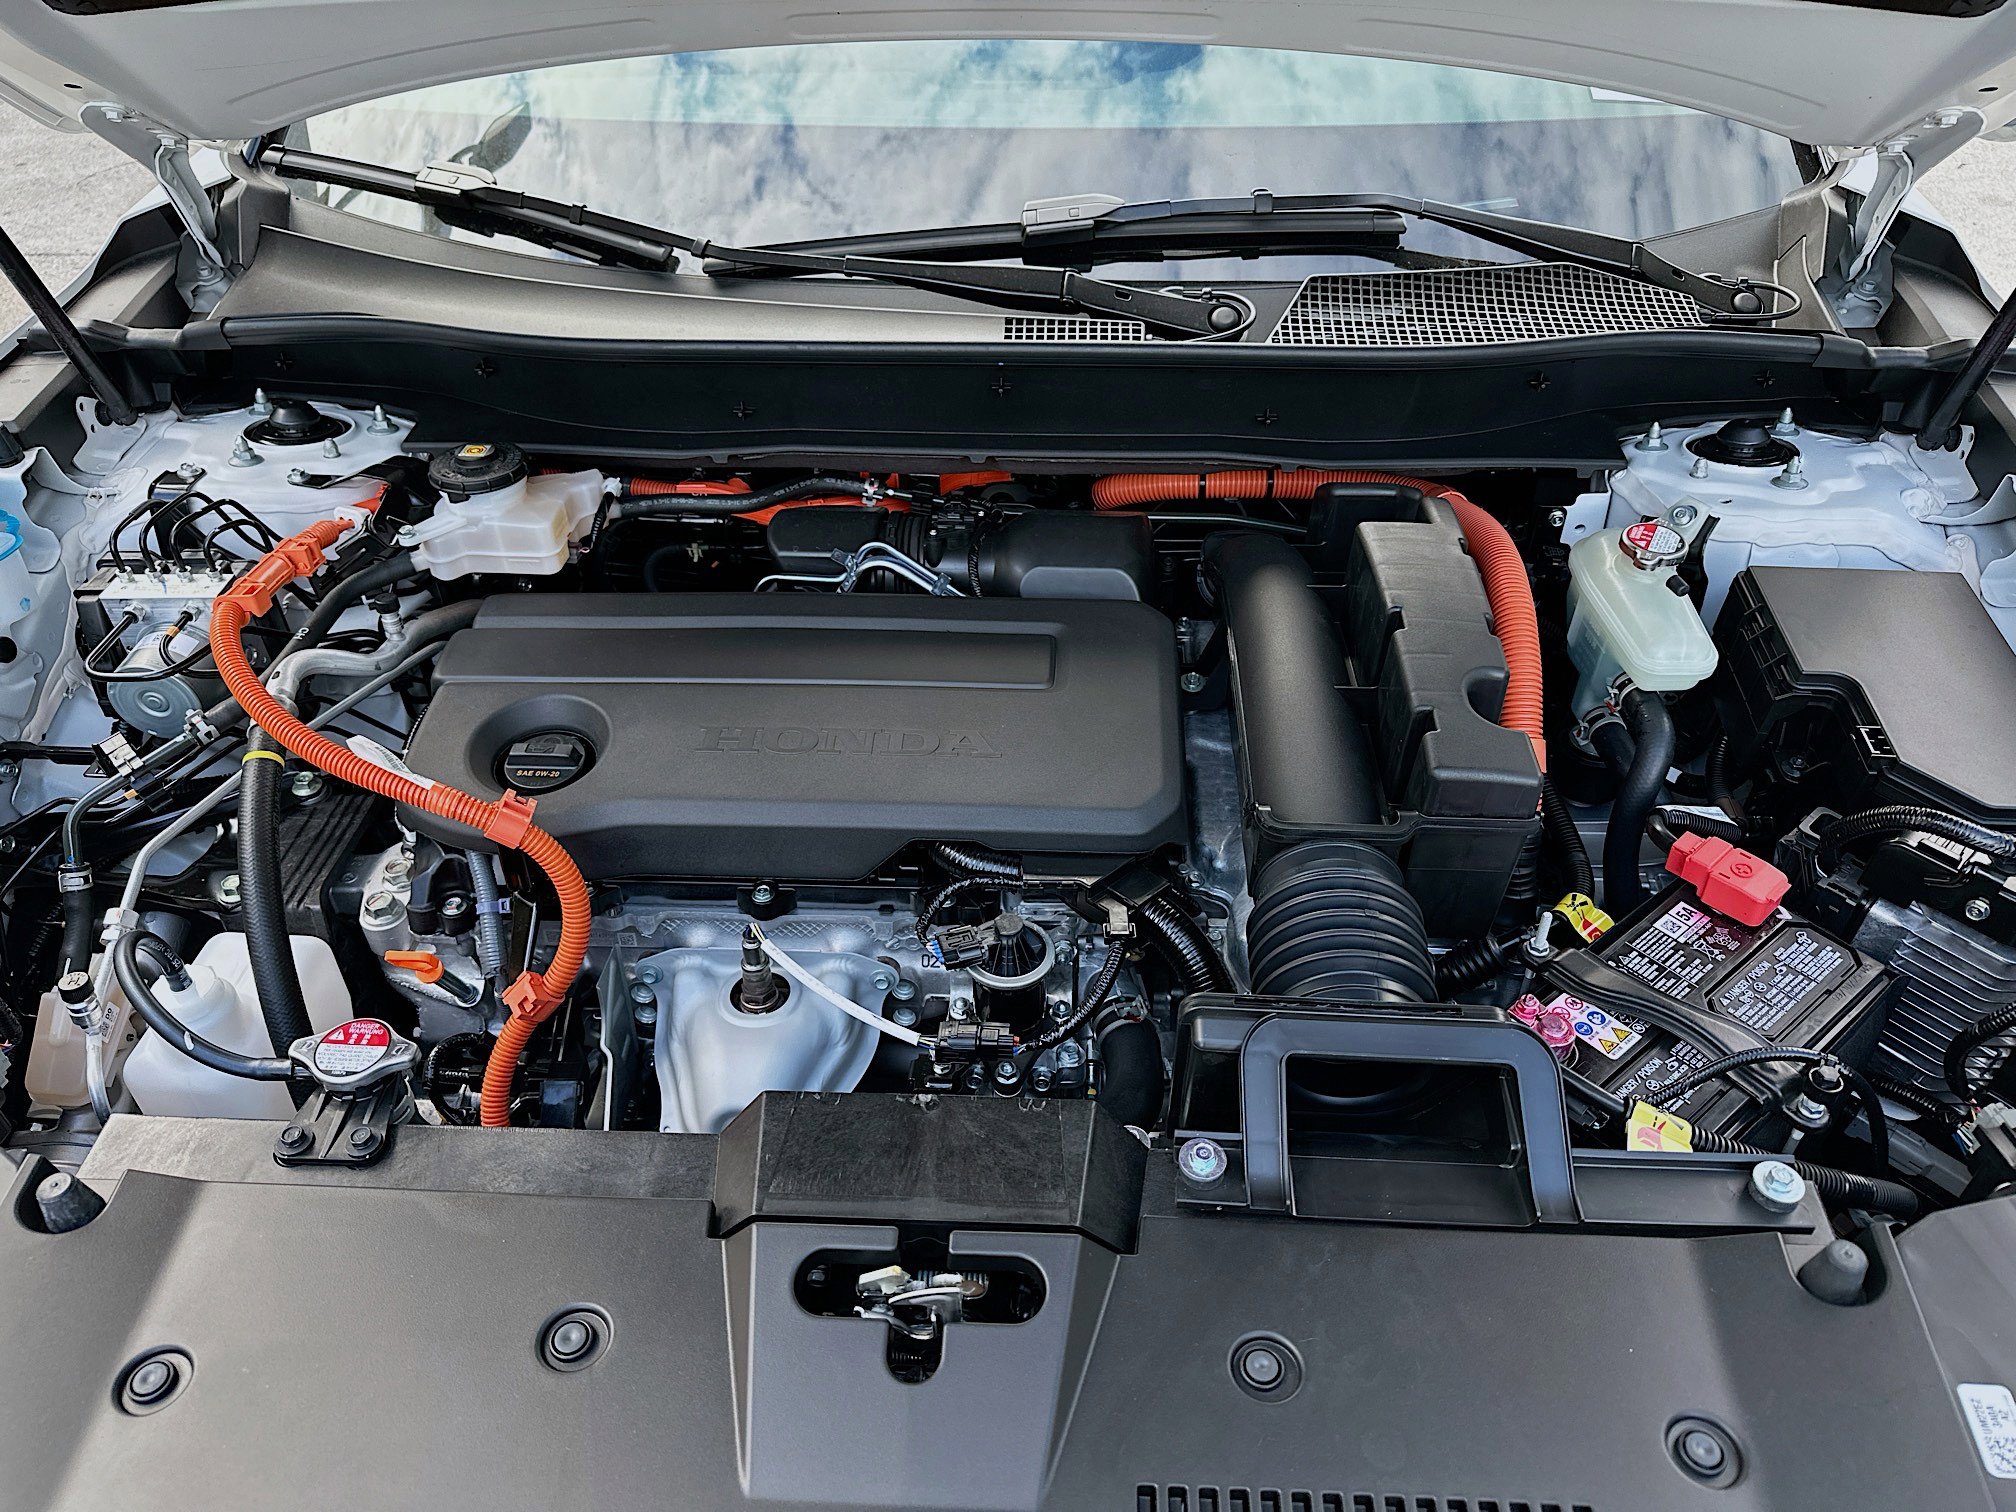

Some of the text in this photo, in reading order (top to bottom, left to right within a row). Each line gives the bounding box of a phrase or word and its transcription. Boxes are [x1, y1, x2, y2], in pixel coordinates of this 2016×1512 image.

[292, 627, 309, 640] CH
[695, 726, 1003, 758] HONDA
[516, 769, 534, 777] SAE
[1676, 906, 1698, 921] 5A
[921, 954, 940, 968] 02
[1725, 979, 1749, 1001] DANGER
[1750, 960, 1772, 980] POISON
[350, 1022, 381, 1030] DANGER
[1638, 1057, 1663, 1079] POISON
